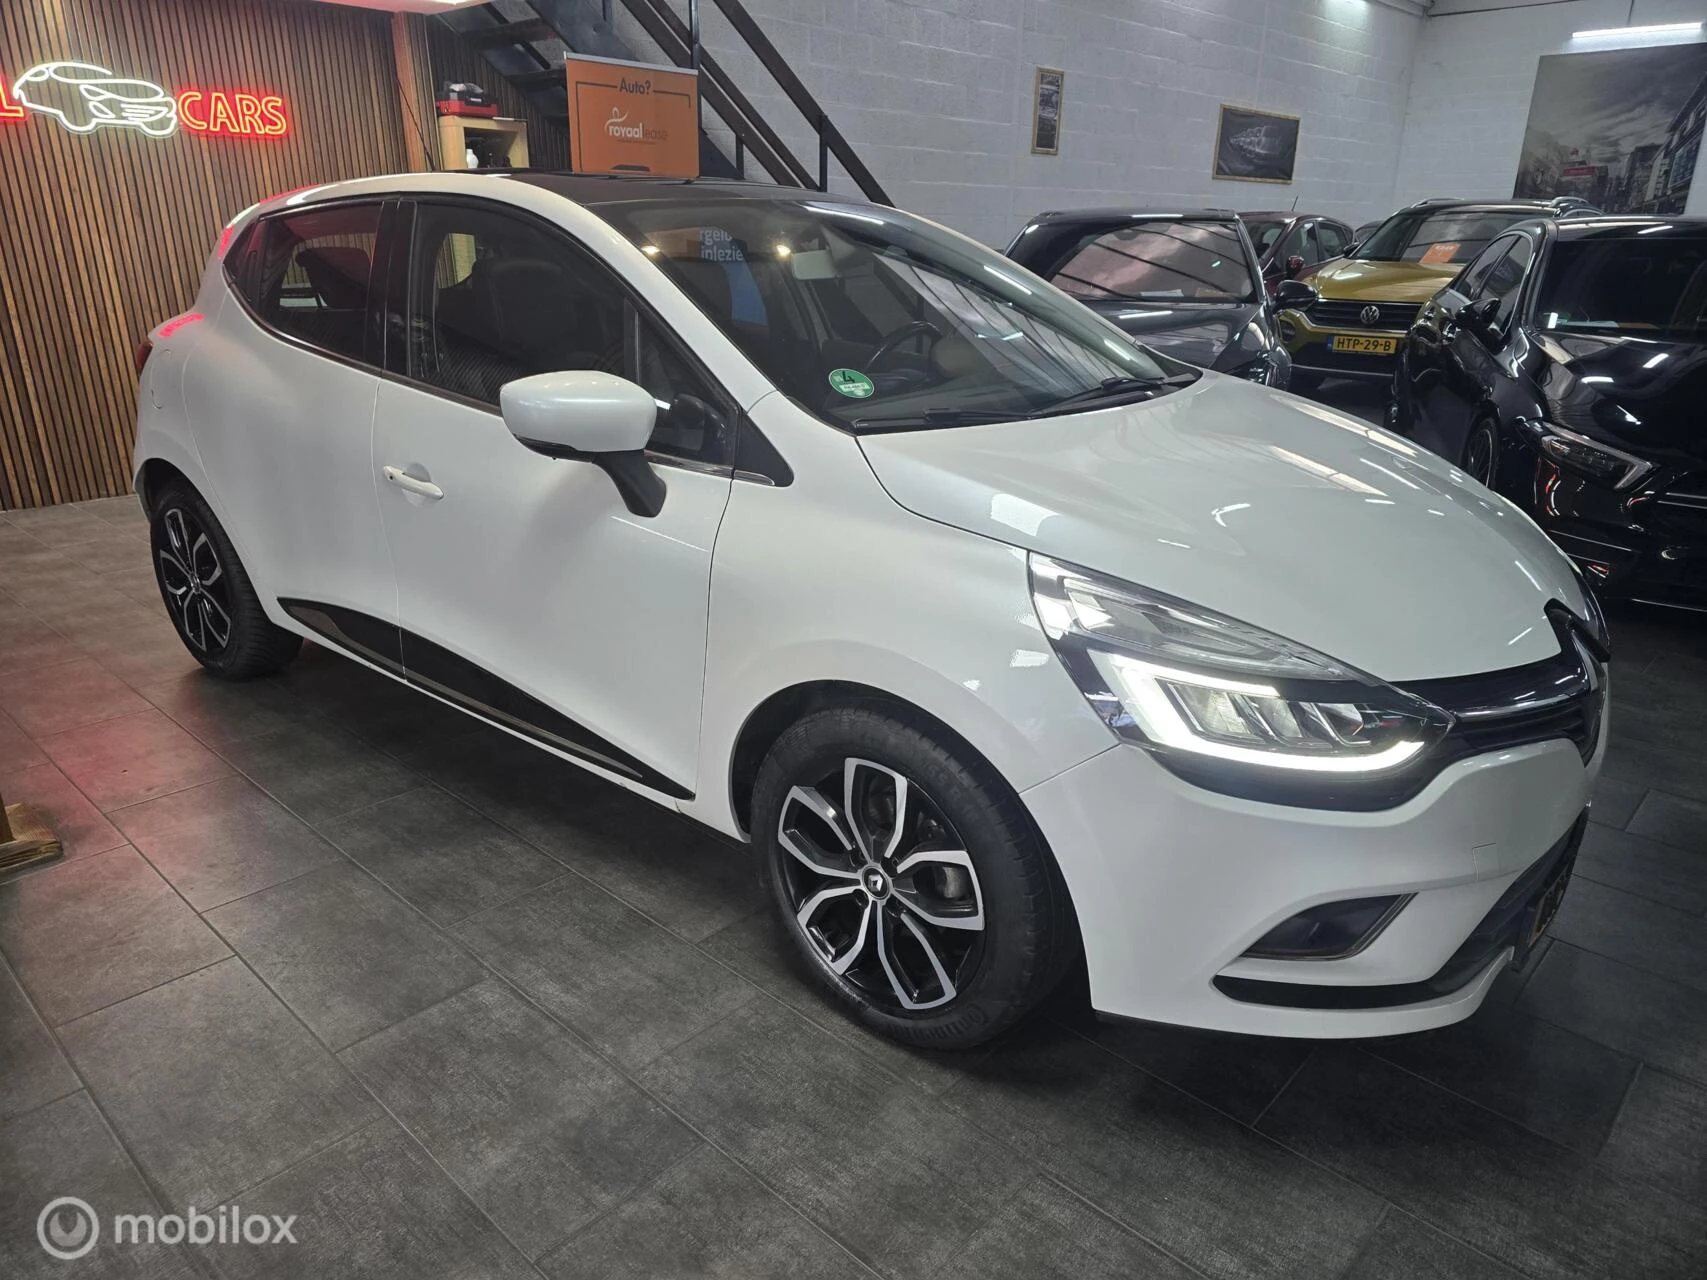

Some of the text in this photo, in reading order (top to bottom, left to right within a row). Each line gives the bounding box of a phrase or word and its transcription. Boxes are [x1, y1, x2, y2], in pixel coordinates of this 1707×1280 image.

[619, 78, 651, 95] Auto?
[178, 91, 287, 135] CARS
[1336, 337, 1392, 351] HTP-29-B
[842, 370, 856, 383] 4
